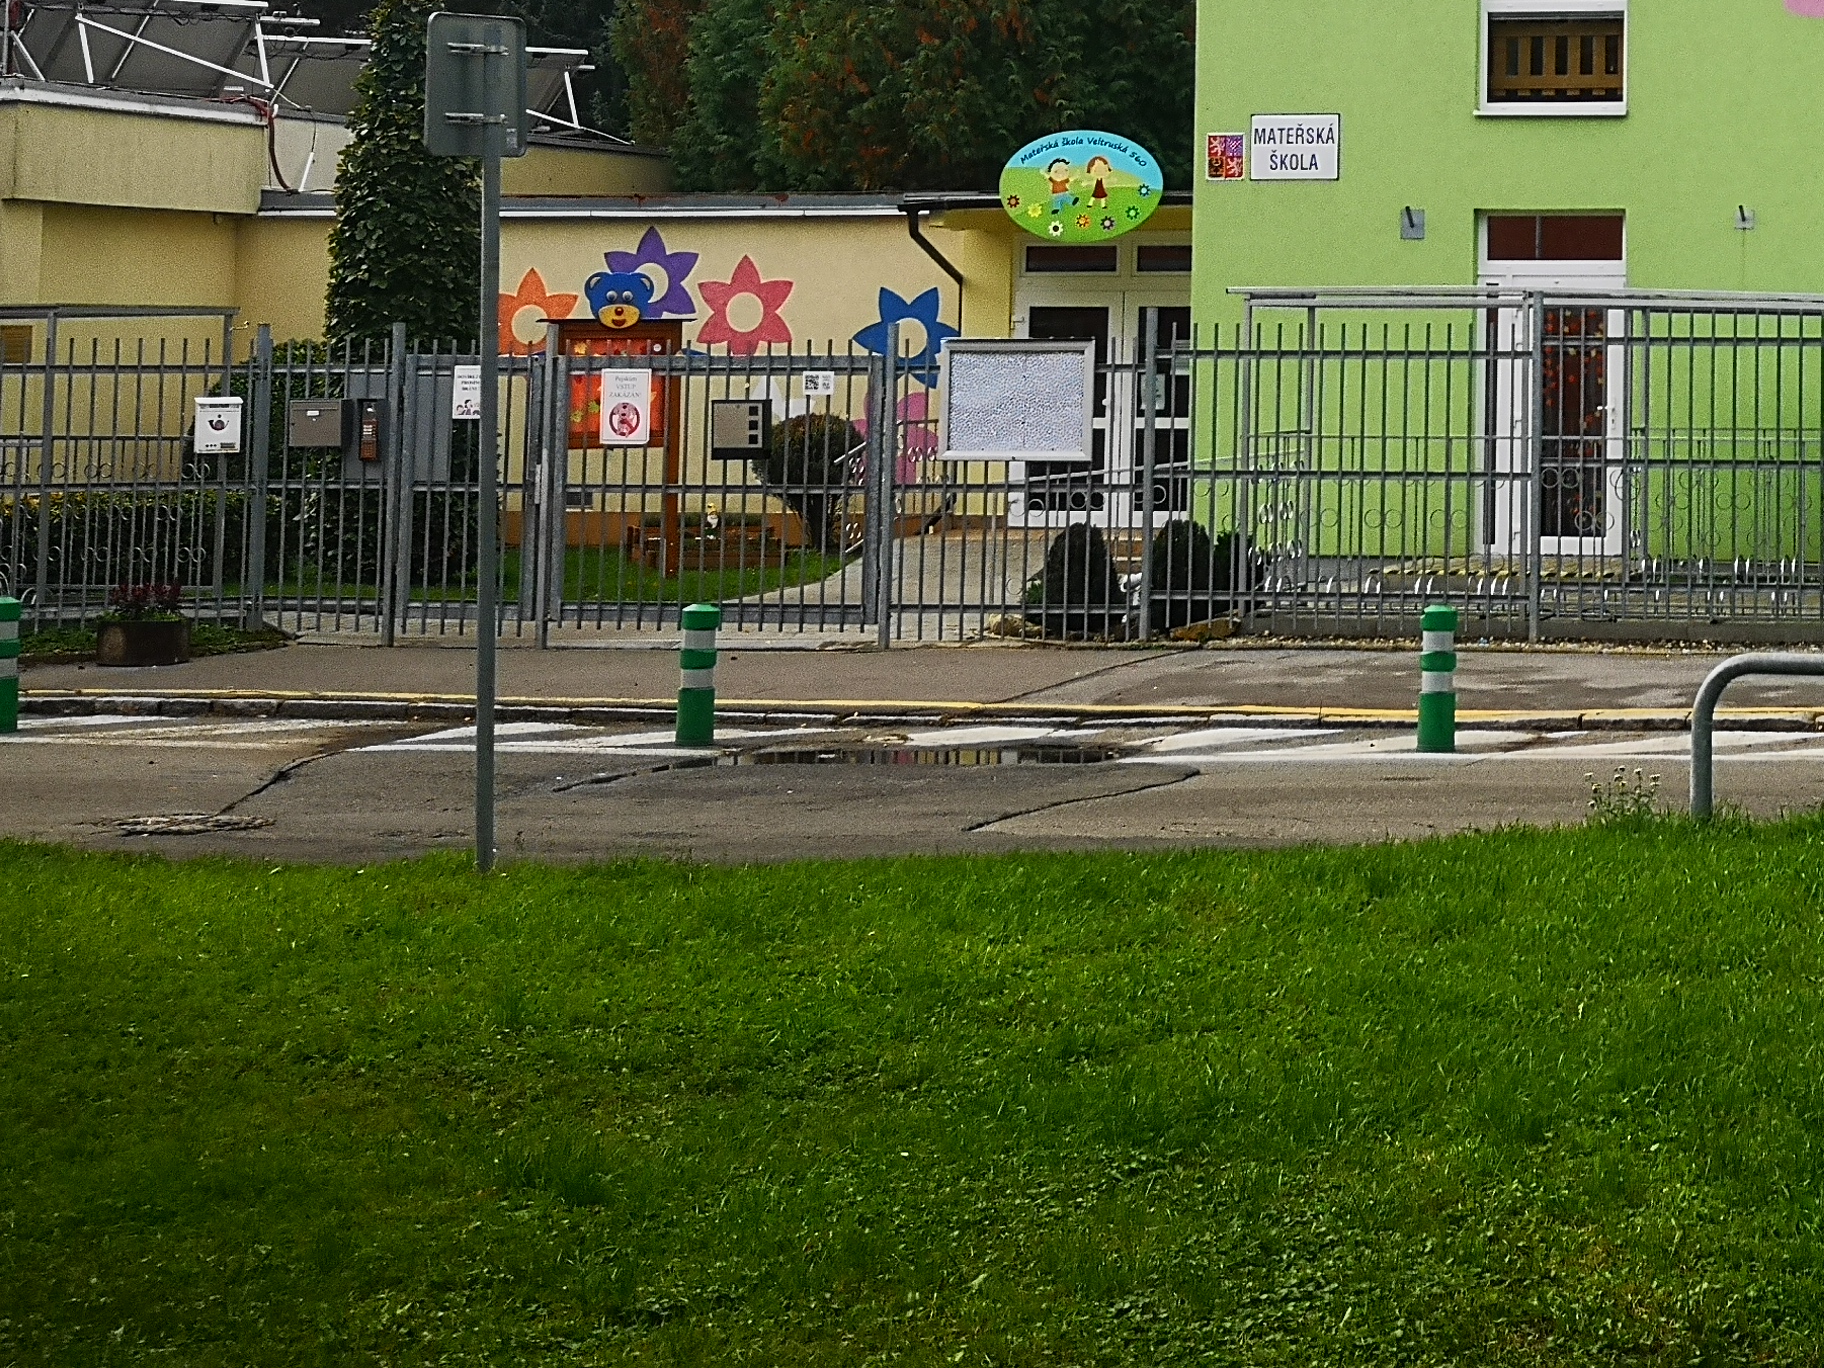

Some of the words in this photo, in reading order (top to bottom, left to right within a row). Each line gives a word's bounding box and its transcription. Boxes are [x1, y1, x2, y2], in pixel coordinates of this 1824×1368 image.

[1254, 123, 1335, 145] MATEŘSKÁ
[1020, 141, 1059, 165] Mateřská
[1061, 136, 1084, 147] škola
[1086, 137, 1128, 154] Veltruská
[1129, 151, 1147, 167] 560
[1269, 149, 1319, 171] ŠKOLA
